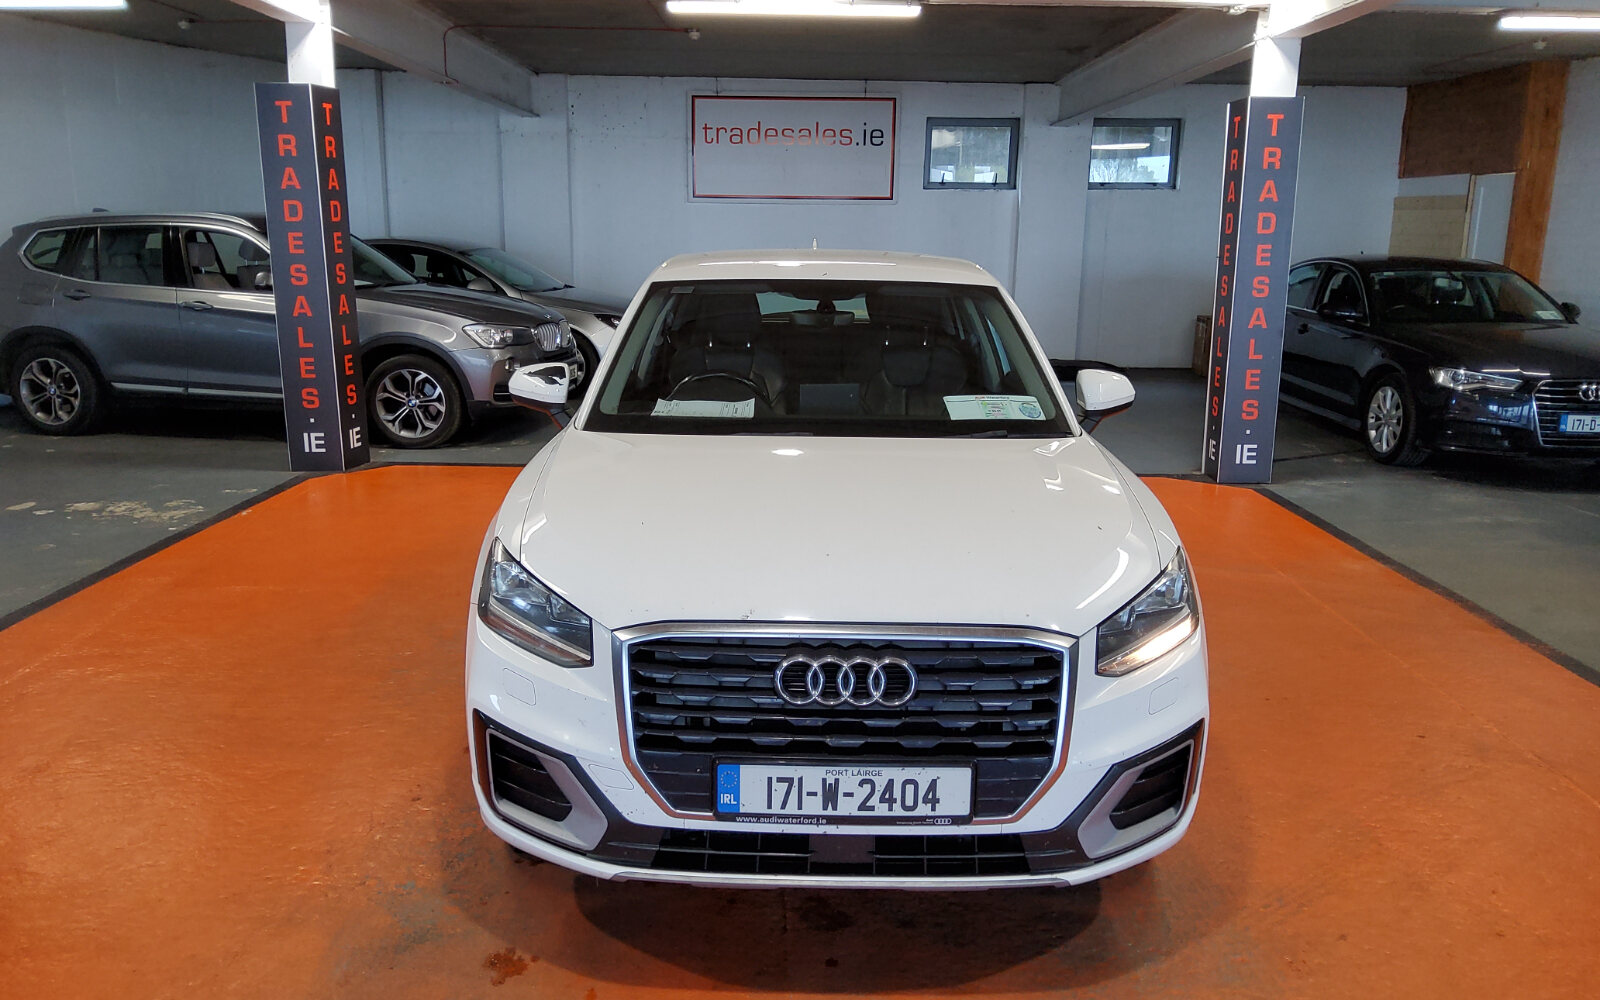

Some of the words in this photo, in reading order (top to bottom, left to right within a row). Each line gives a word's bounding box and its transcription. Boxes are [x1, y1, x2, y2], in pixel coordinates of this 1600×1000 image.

[702, 120, 884, 147] tradesales.ie
[825, 769, 849, 777] PORT
[851, 768, 883, 777] LÁIRGE
[720, 793, 737, 805] IRL
[766, 775, 940, 812] 171-W-2404
[736, 815, 827, 825] www.audiwaterford.ie
